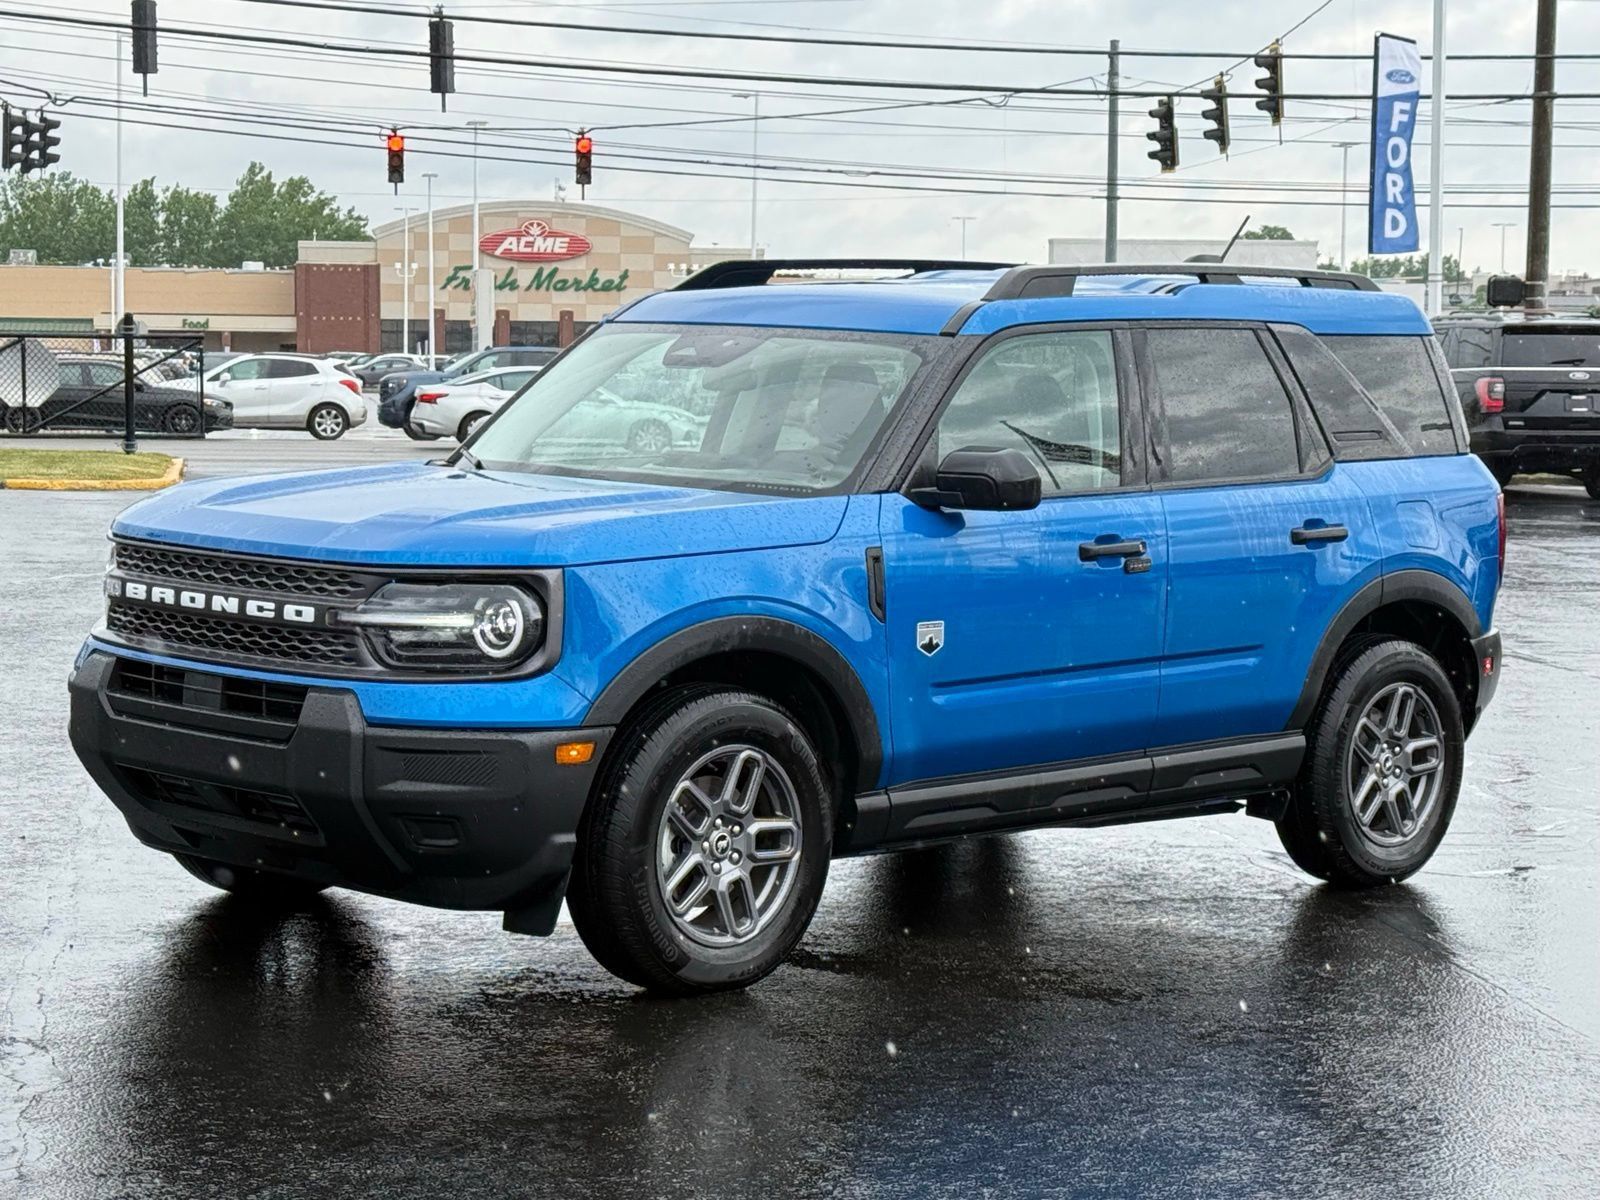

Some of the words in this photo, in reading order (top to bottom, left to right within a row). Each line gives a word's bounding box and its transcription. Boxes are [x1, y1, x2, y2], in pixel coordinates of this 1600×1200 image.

[1384, 101, 1412, 238] FORD
[494, 236, 570, 256] ACME
[440, 264, 520, 291] Frh
[525, 266, 629, 292] Market
[125, 582, 315, 623] BRONCO
